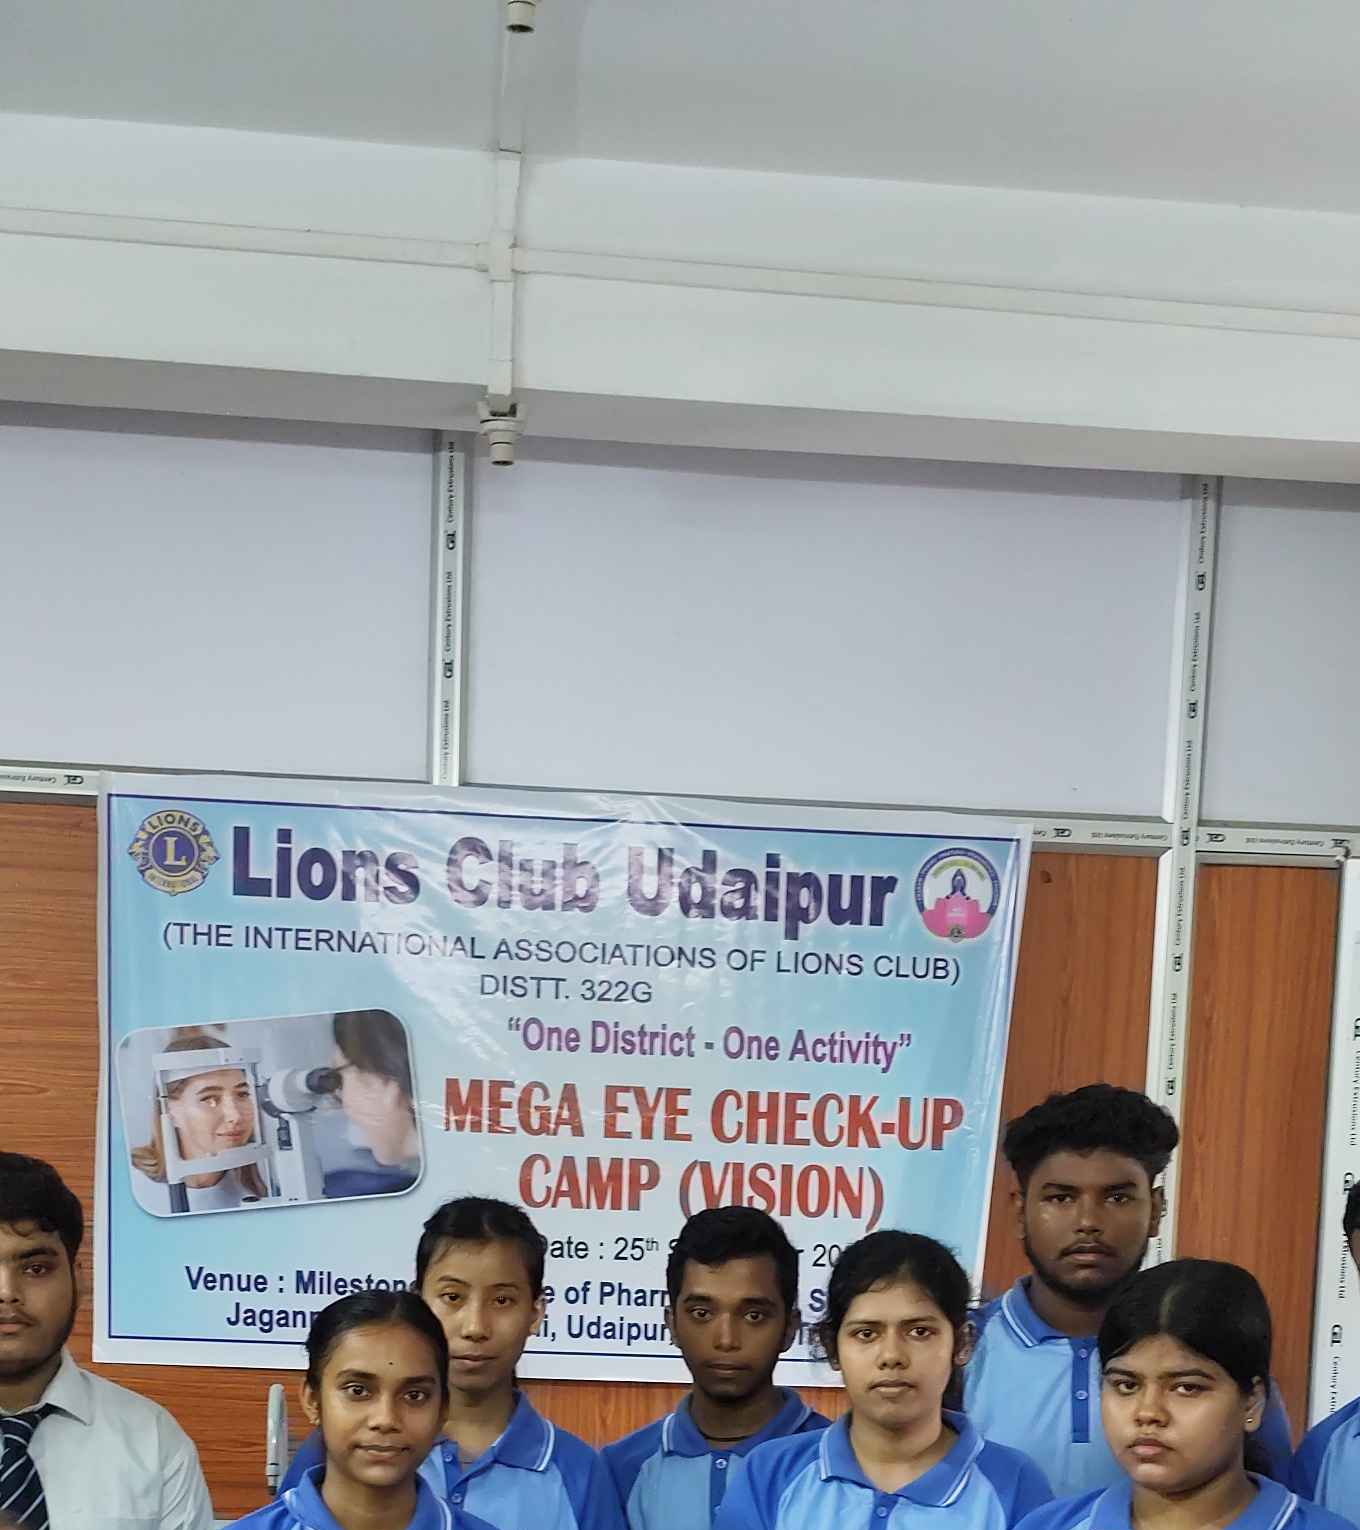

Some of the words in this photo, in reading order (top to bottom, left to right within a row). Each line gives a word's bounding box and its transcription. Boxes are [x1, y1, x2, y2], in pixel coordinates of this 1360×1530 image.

[147, 813, 201, 833] LIONS
[163, 836, 188, 866] L
[233, 825, 421, 904] Lions
[446, 836, 601, 914] Club
[626, 846, 899, 941] Udaipur
[162, 921, 234, 951] (THE
[244, 926, 487, 960] INTERNATIONAL
[493, 936, 717, 970] ASSOCIATIONS
[726, 947, 767, 972] OF
[776, 951, 865, 977] LIONS
[873, 954, 961, 985] CLUB)
[479, 973, 568, 1000] DISTT.
[581, 980, 653, 1003] 322G
[590, 1020, 696, 1059] District
[723, 1026, 782, 1061] One
[443, 1077, 585, 1138] MEGA
[603, 1084, 693, 1143] EYE
[710, 1089, 965, 1151] CHECK-UP
[518, 1153, 661, 1210] CAMP
[679, 1158, 885, 1234] (VISION)
[185, 1265, 269, 1292] Venue
[278, 1274, 285, 1293] :
[564, 1280, 591, 1304] of
